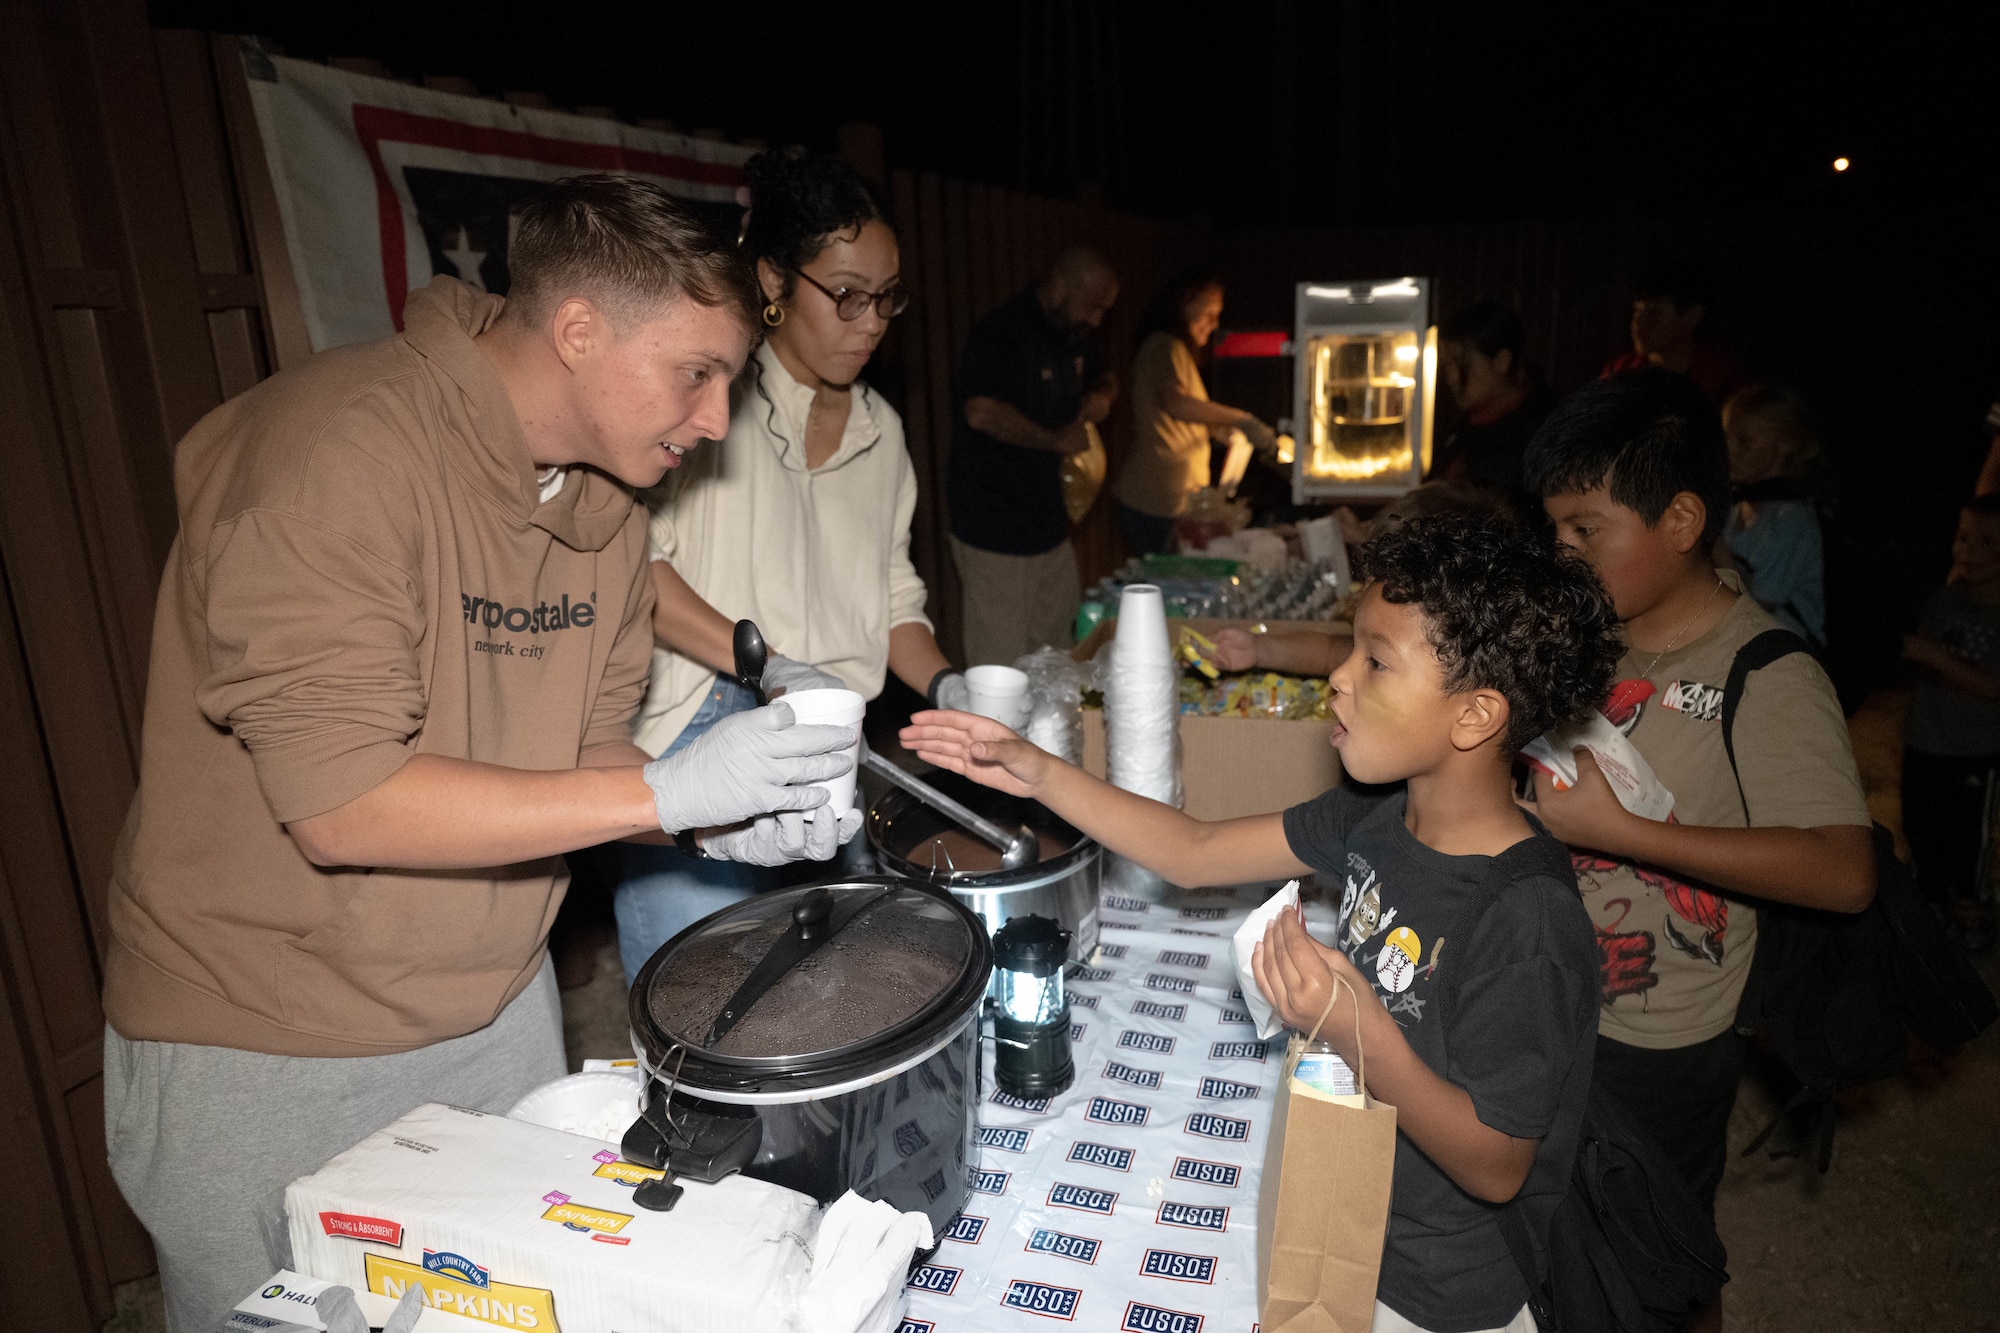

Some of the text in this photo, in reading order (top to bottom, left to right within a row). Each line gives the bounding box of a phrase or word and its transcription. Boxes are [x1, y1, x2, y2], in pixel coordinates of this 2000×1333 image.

[520, 644, 546, 660] city
[1114, 897, 1141, 912] USO
[1168, 953, 1200, 968] USO
[1153, 975, 1187, 992] USO
[1148, 1003, 1177, 1020] USO
[1130, 1033, 1164, 1051] USO
[1222, 1043, 1256, 1058] USO
[1116, 1066, 1151, 1086] USO
[1211, 1081, 1248, 1099] USO
[1100, 1100, 1136, 1123] USO
[1200, 1116, 1237, 1138] USO
[981, 1129, 1019, 1148] USO
[1082, 1144, 1120, 1167] USO
[1187, 1162, 1226, 1183] USO
[546, 1195, 565, 1204] 500
[1063, 1189, 1102, 1207] USO
[553, 1208, 623, 1229] NAPKINS
[1172, 1205, 1213, 1227] USO
[1042, 1231, 1084, 1257] USO
[427, 1255, 485, 1286] HILL COUNTRY FARE
[1158, 1253, 1201, 1277] USO
[1019, 1285, 1065, 1312] USO
[1140, 1308, 1186, 1333] USO
